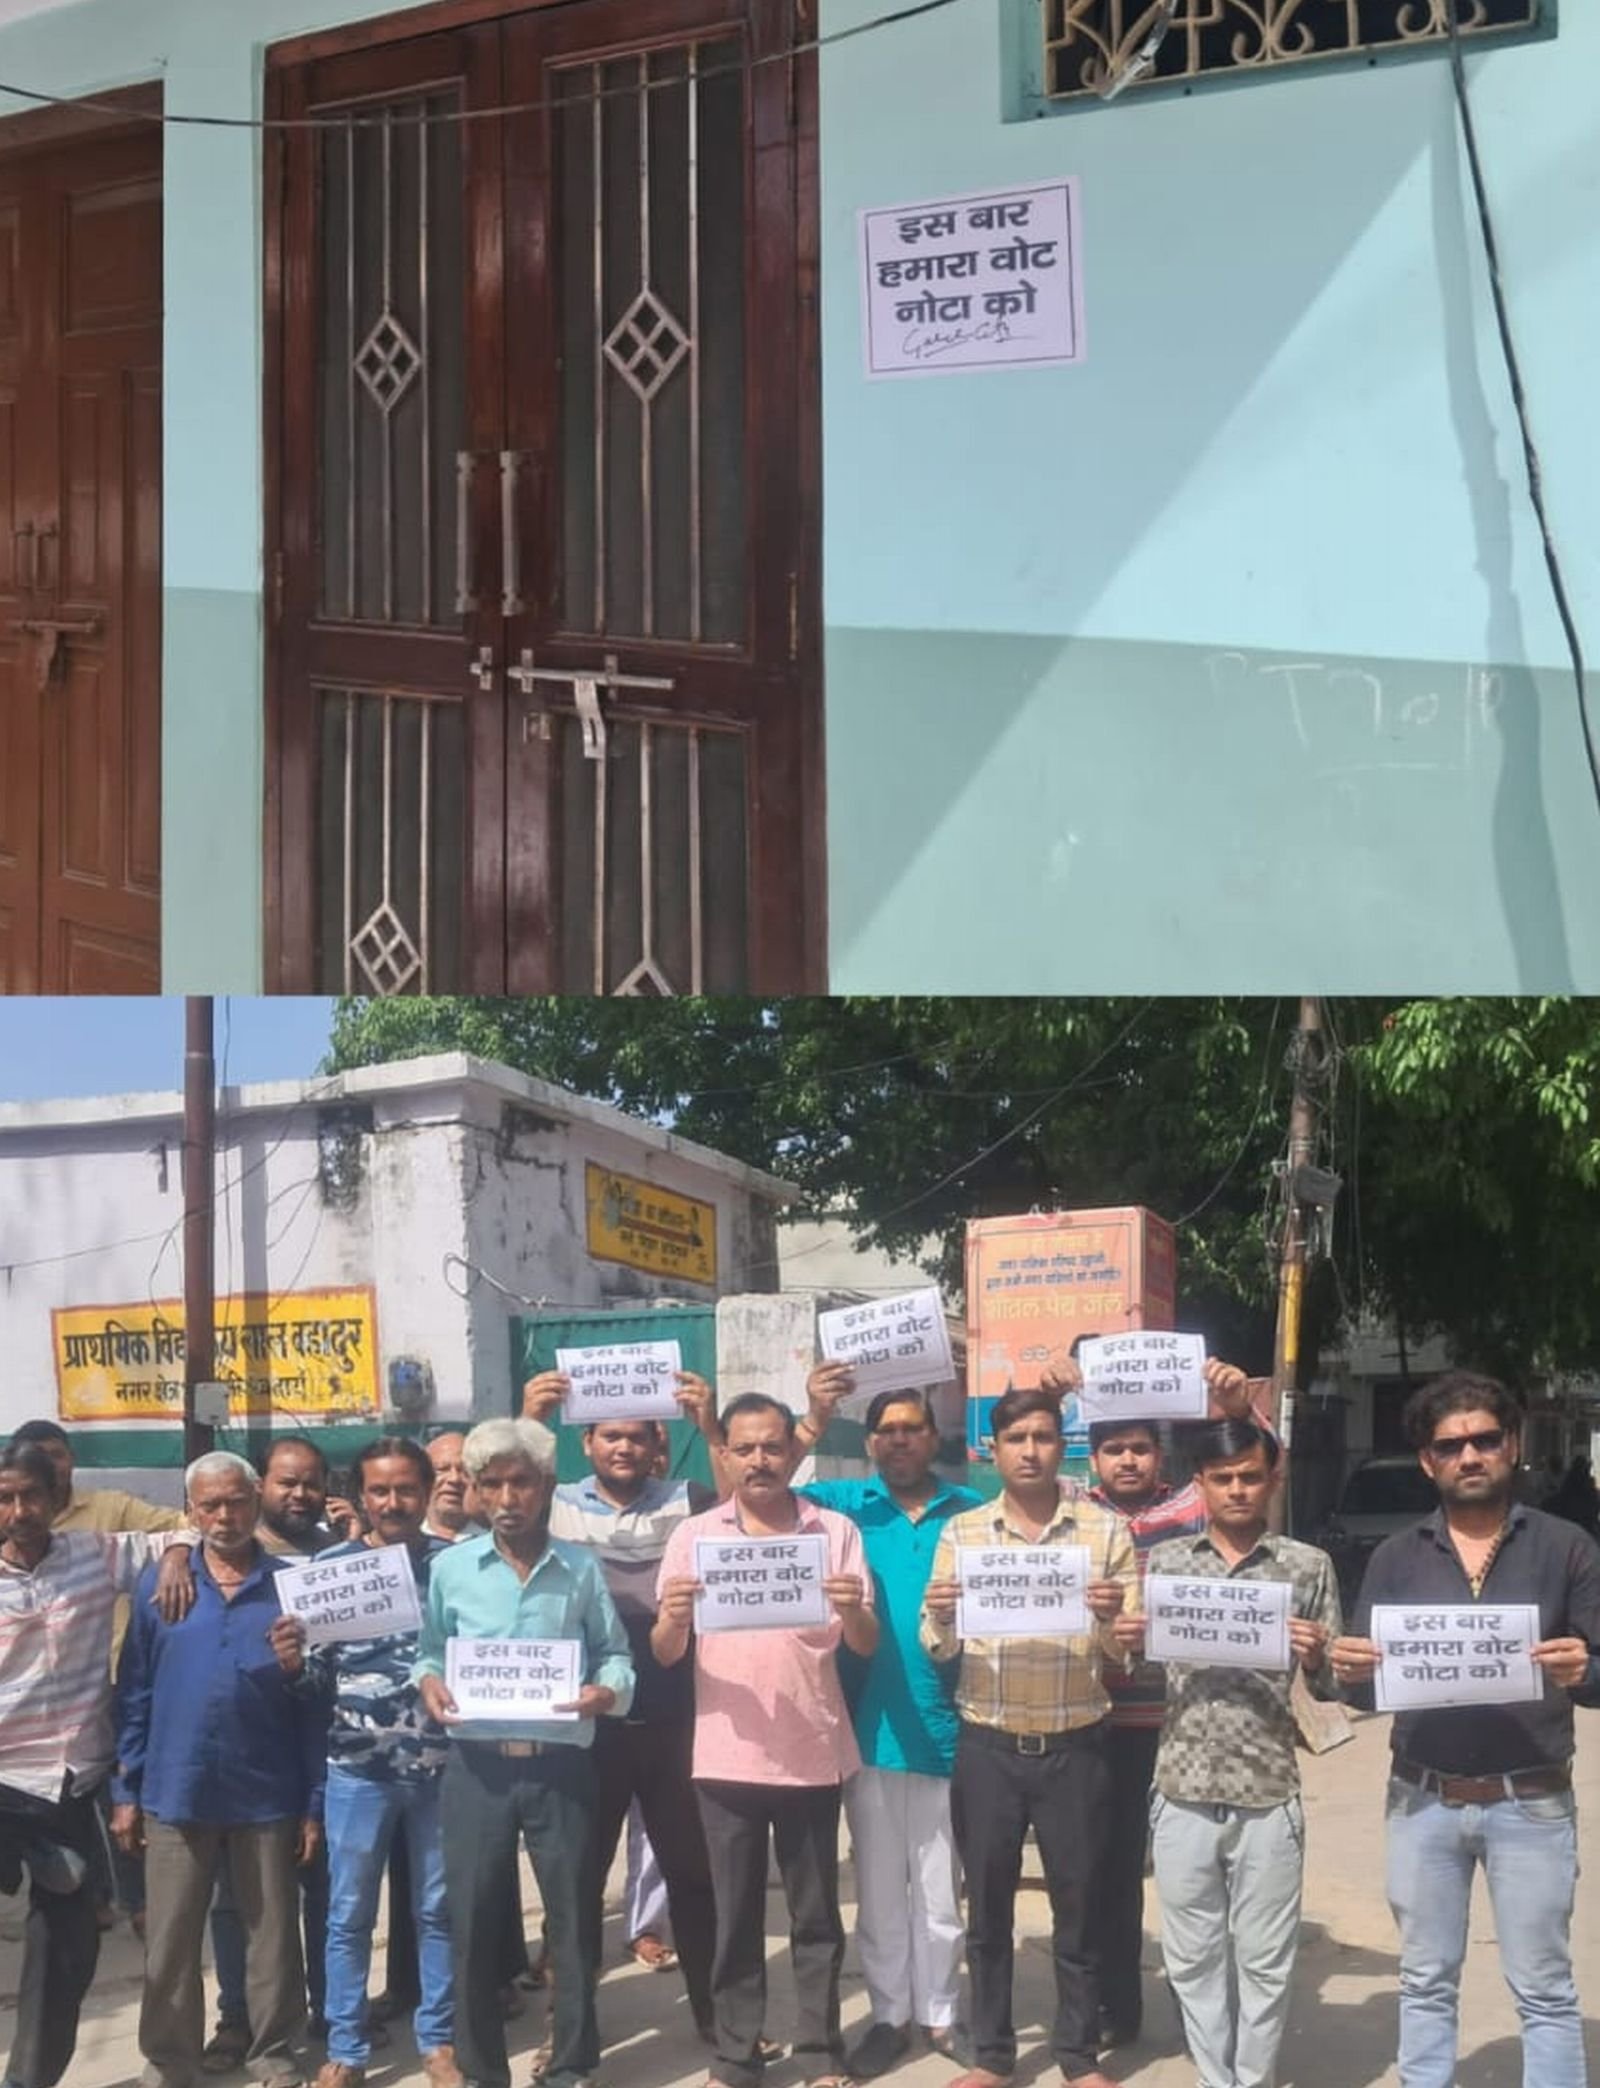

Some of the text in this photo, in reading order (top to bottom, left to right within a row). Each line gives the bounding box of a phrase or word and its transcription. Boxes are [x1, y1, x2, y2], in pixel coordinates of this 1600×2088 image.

[897, 200, 1033, 244] इस बार
[877, 236, 1058, 288] हमारा वोट
[895, 280, 1038, 323] नोटा को
[835, 1315, 933, 1351] हमारा वोट
[63, 1320, 150, 1369] प्राथमिक
[896, 1336, 925, 1356] को
[1103, 1337, 1178, 1355] इस बार
[570, 1358, 669, 1379] हमारा वोट
[1155, 1354, 1193, 1371] वोट
[115, 1381, 151, 1402] नगर
[581, 1379, 659, 1397] नोटा को
[1098, 1374, 1181, 1395] नोटा को
[718, 1545, 799, 1563] इस बार
[981, 1552, 1062, 1567] इस बार
[302, 1557, 381, 1585] इस बार
[705, 1563, 814, 1585] हमारा वोट
[967, 1569, 1076, 1590] हमारा वोट
[294, 1574, 400, 1610] हमारा वोट
[717, 1583, 802, 1605] नोटा को
[978, 1591, 1064, 1609] नोटा को
[1172, 1584, 1261, 1601] इस बार
[309, 1594, 393, 1625] नोटा को
[1158, 1605, 1275, 1625] हमारा वोट
[1403, 1613, 1503, 1632] इस बार
[1168, 1623, 1262, 1646] नोटा को
[474, 1643, 554, 1659] इस बार
[1386, 1635, 1522, 1657] हमारा वोट
[459, 1663, 566, 1681] हमारा वोट
[1401, 1659, 1508, 1681] नोटा को
[468, 1683, 552, 1700] नोटा को
